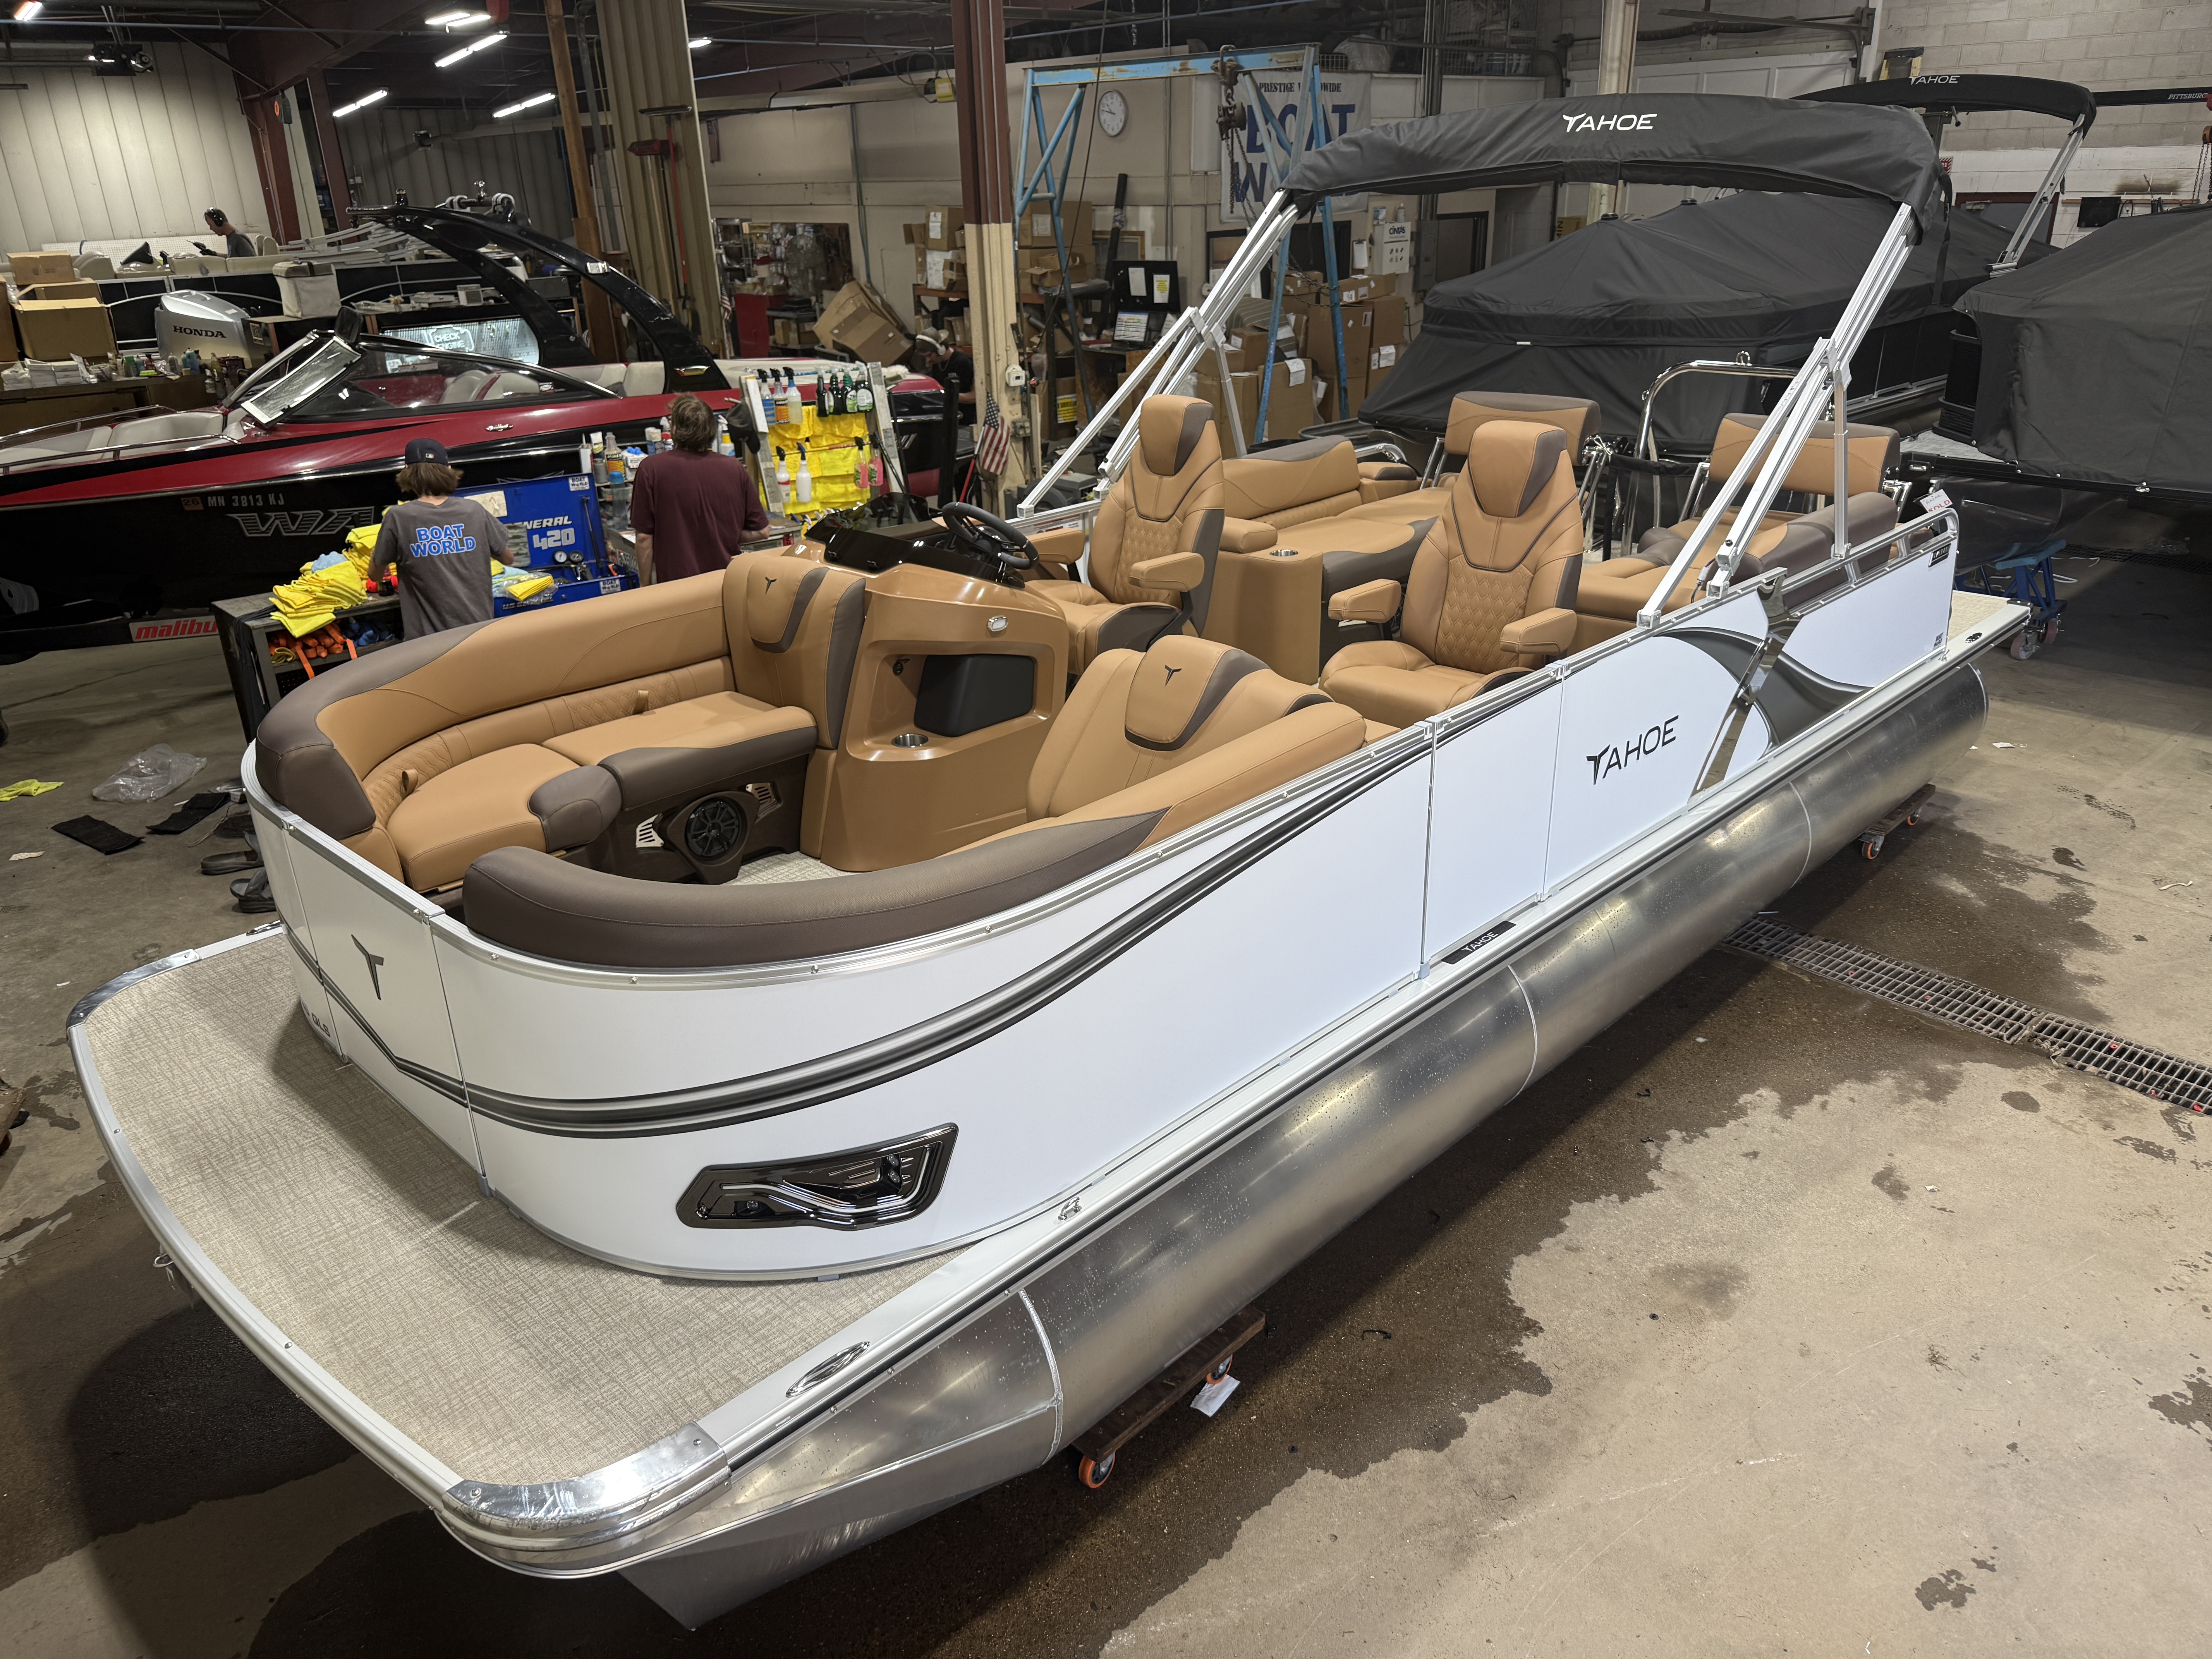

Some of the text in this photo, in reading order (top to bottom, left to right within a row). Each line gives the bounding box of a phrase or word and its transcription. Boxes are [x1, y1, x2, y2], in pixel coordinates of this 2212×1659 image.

[1259, 82, 1295, 93] PRESTIGE
[1909, 76, 1960, 85] TAHOE
[1563, 113, 1657, 132] TAHOE
[173, 325, 227, 338] HONDA
[434, 332, 460, 342] CHECK
[208, 493, 284, 507] MN 3813 KJ
[504, 516, 572, 530] NERAL
[416, 524, 465, 542] BOAT
[532, 527, 575, 550] 420
[410, 536, 476, 558] WORLD
[136, 620, 218, 640] malibu
[1586, 715, 1679, 785] TAHOE
[1461, 932, 1498, 951] TAHOE
[311, 1012, 331, 1037] QLS
